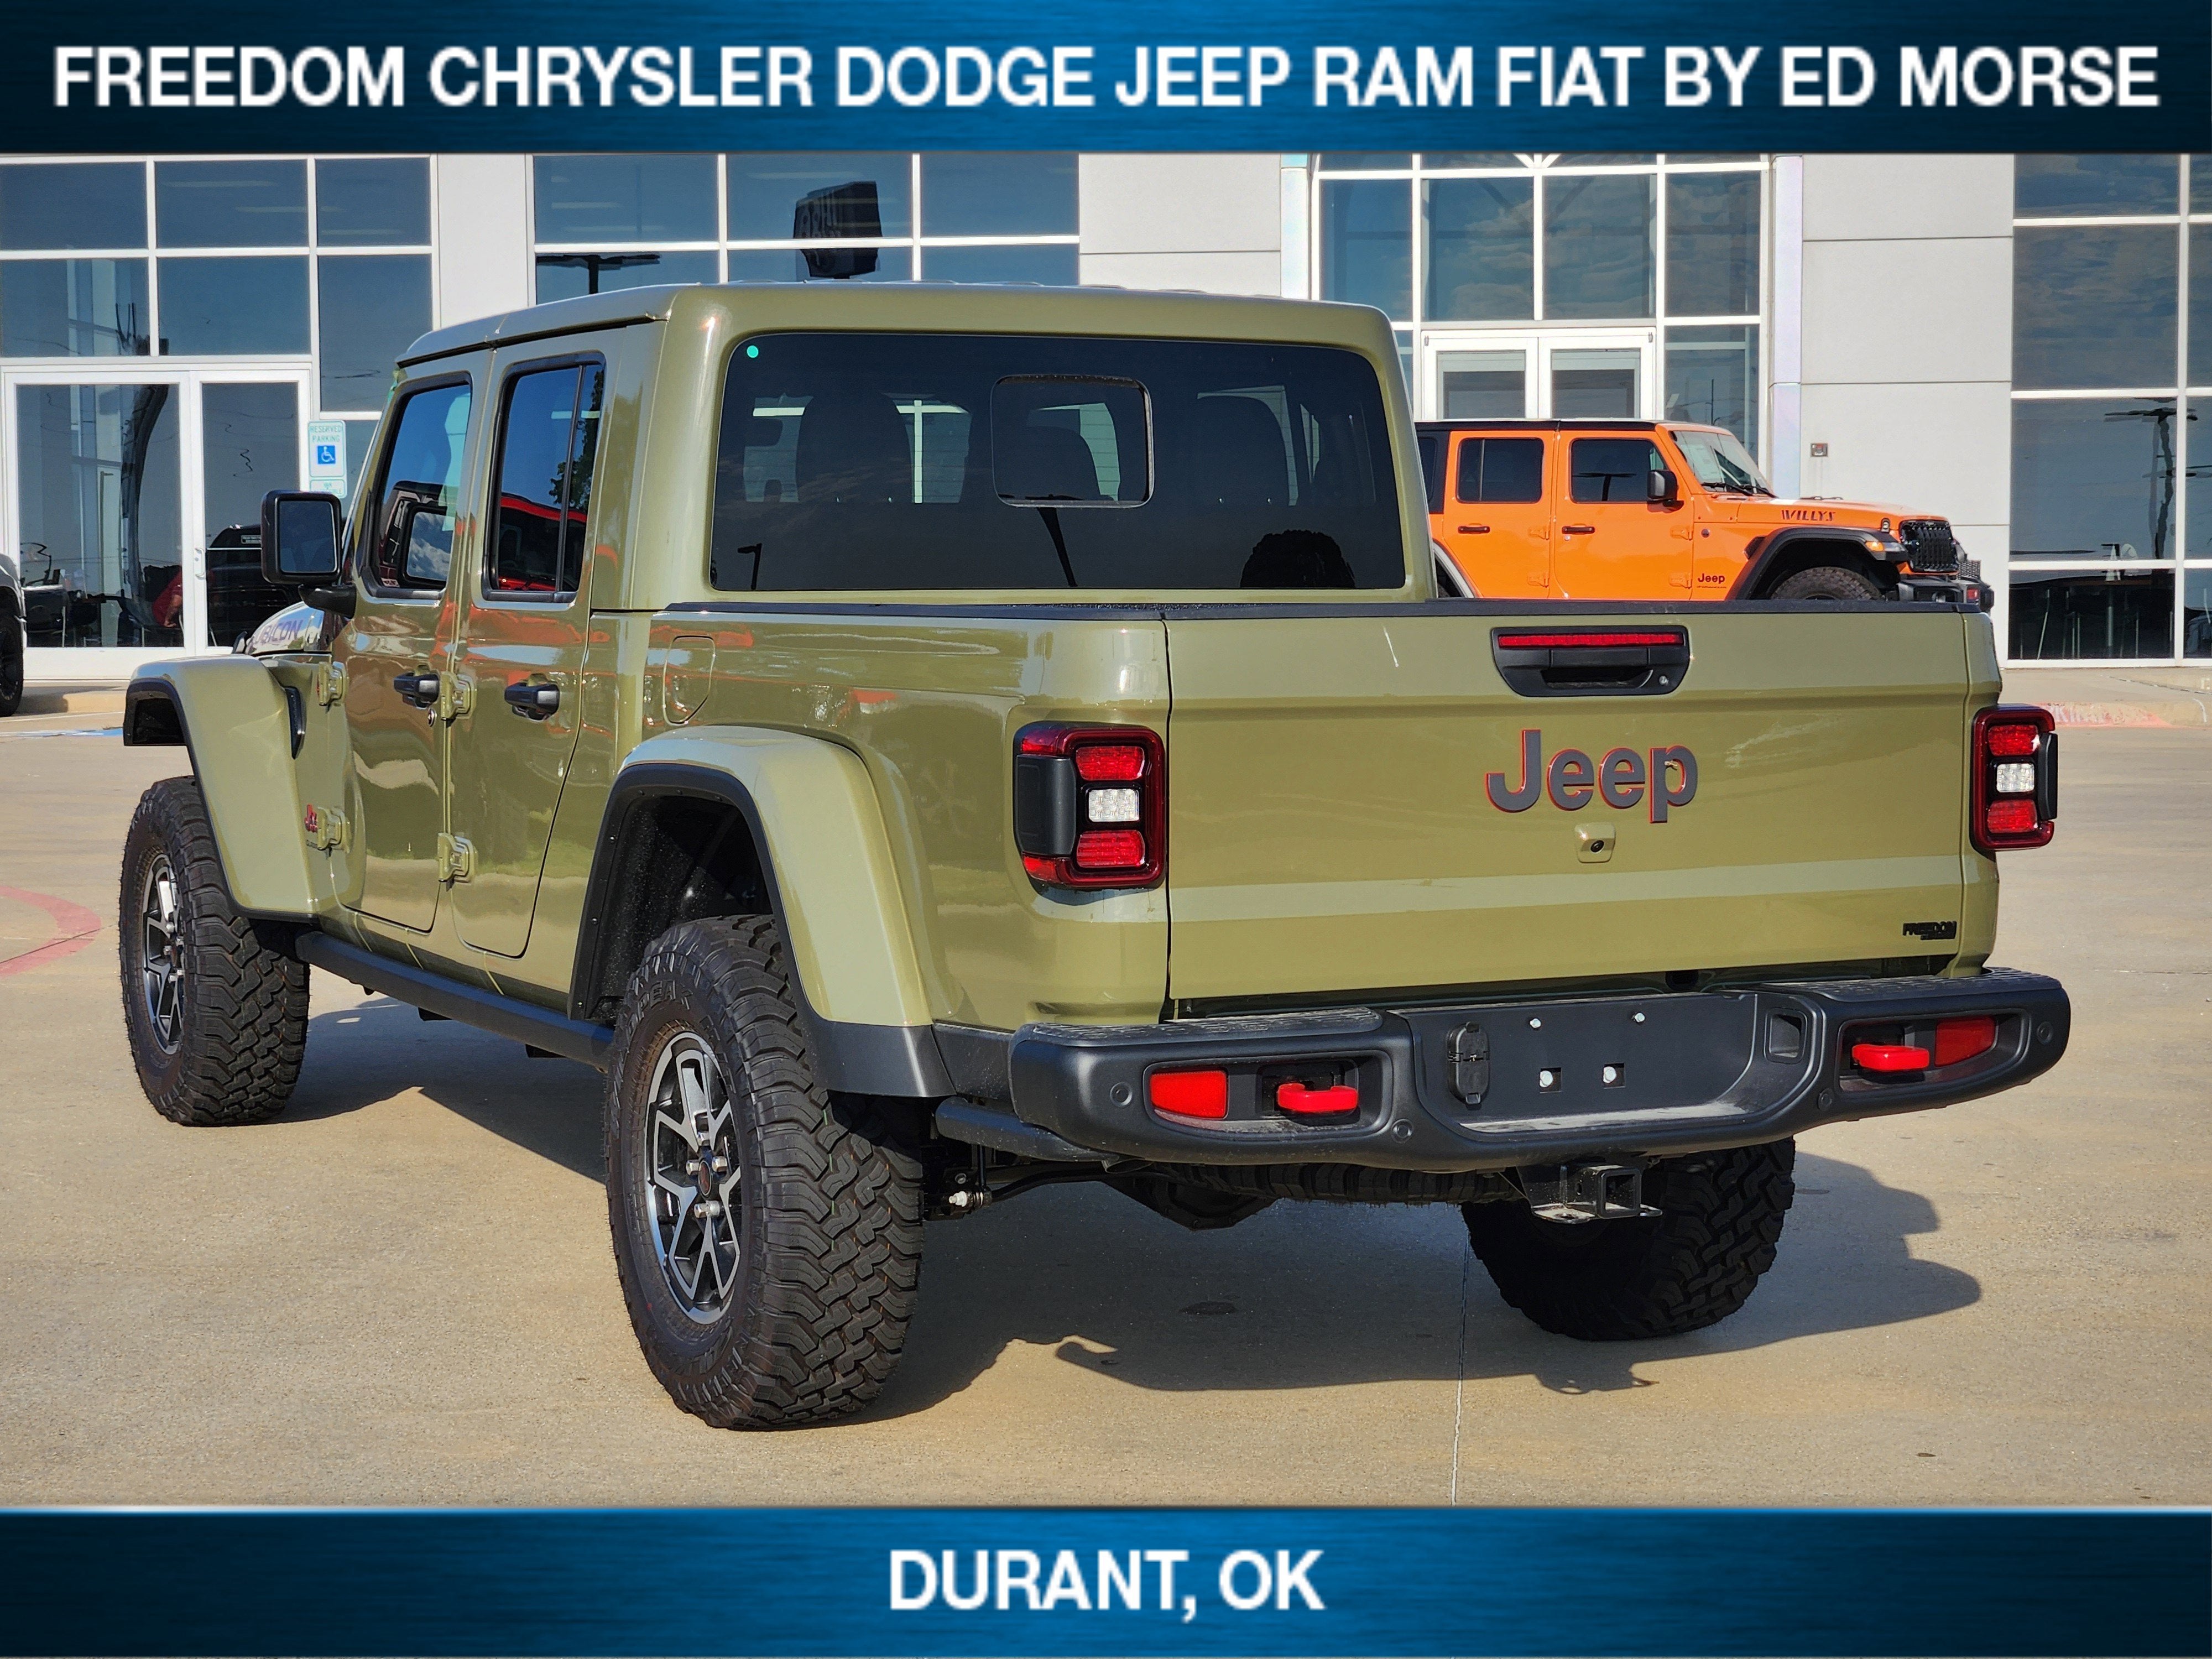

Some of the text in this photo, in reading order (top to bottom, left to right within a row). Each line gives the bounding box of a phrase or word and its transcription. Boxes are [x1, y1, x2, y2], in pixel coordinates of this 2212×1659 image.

[1781, 509, 1835, 521] WILLYS
[1697, 573, 1725, 584] Jeep
[1485, 729, 1698, 823] Jeep
